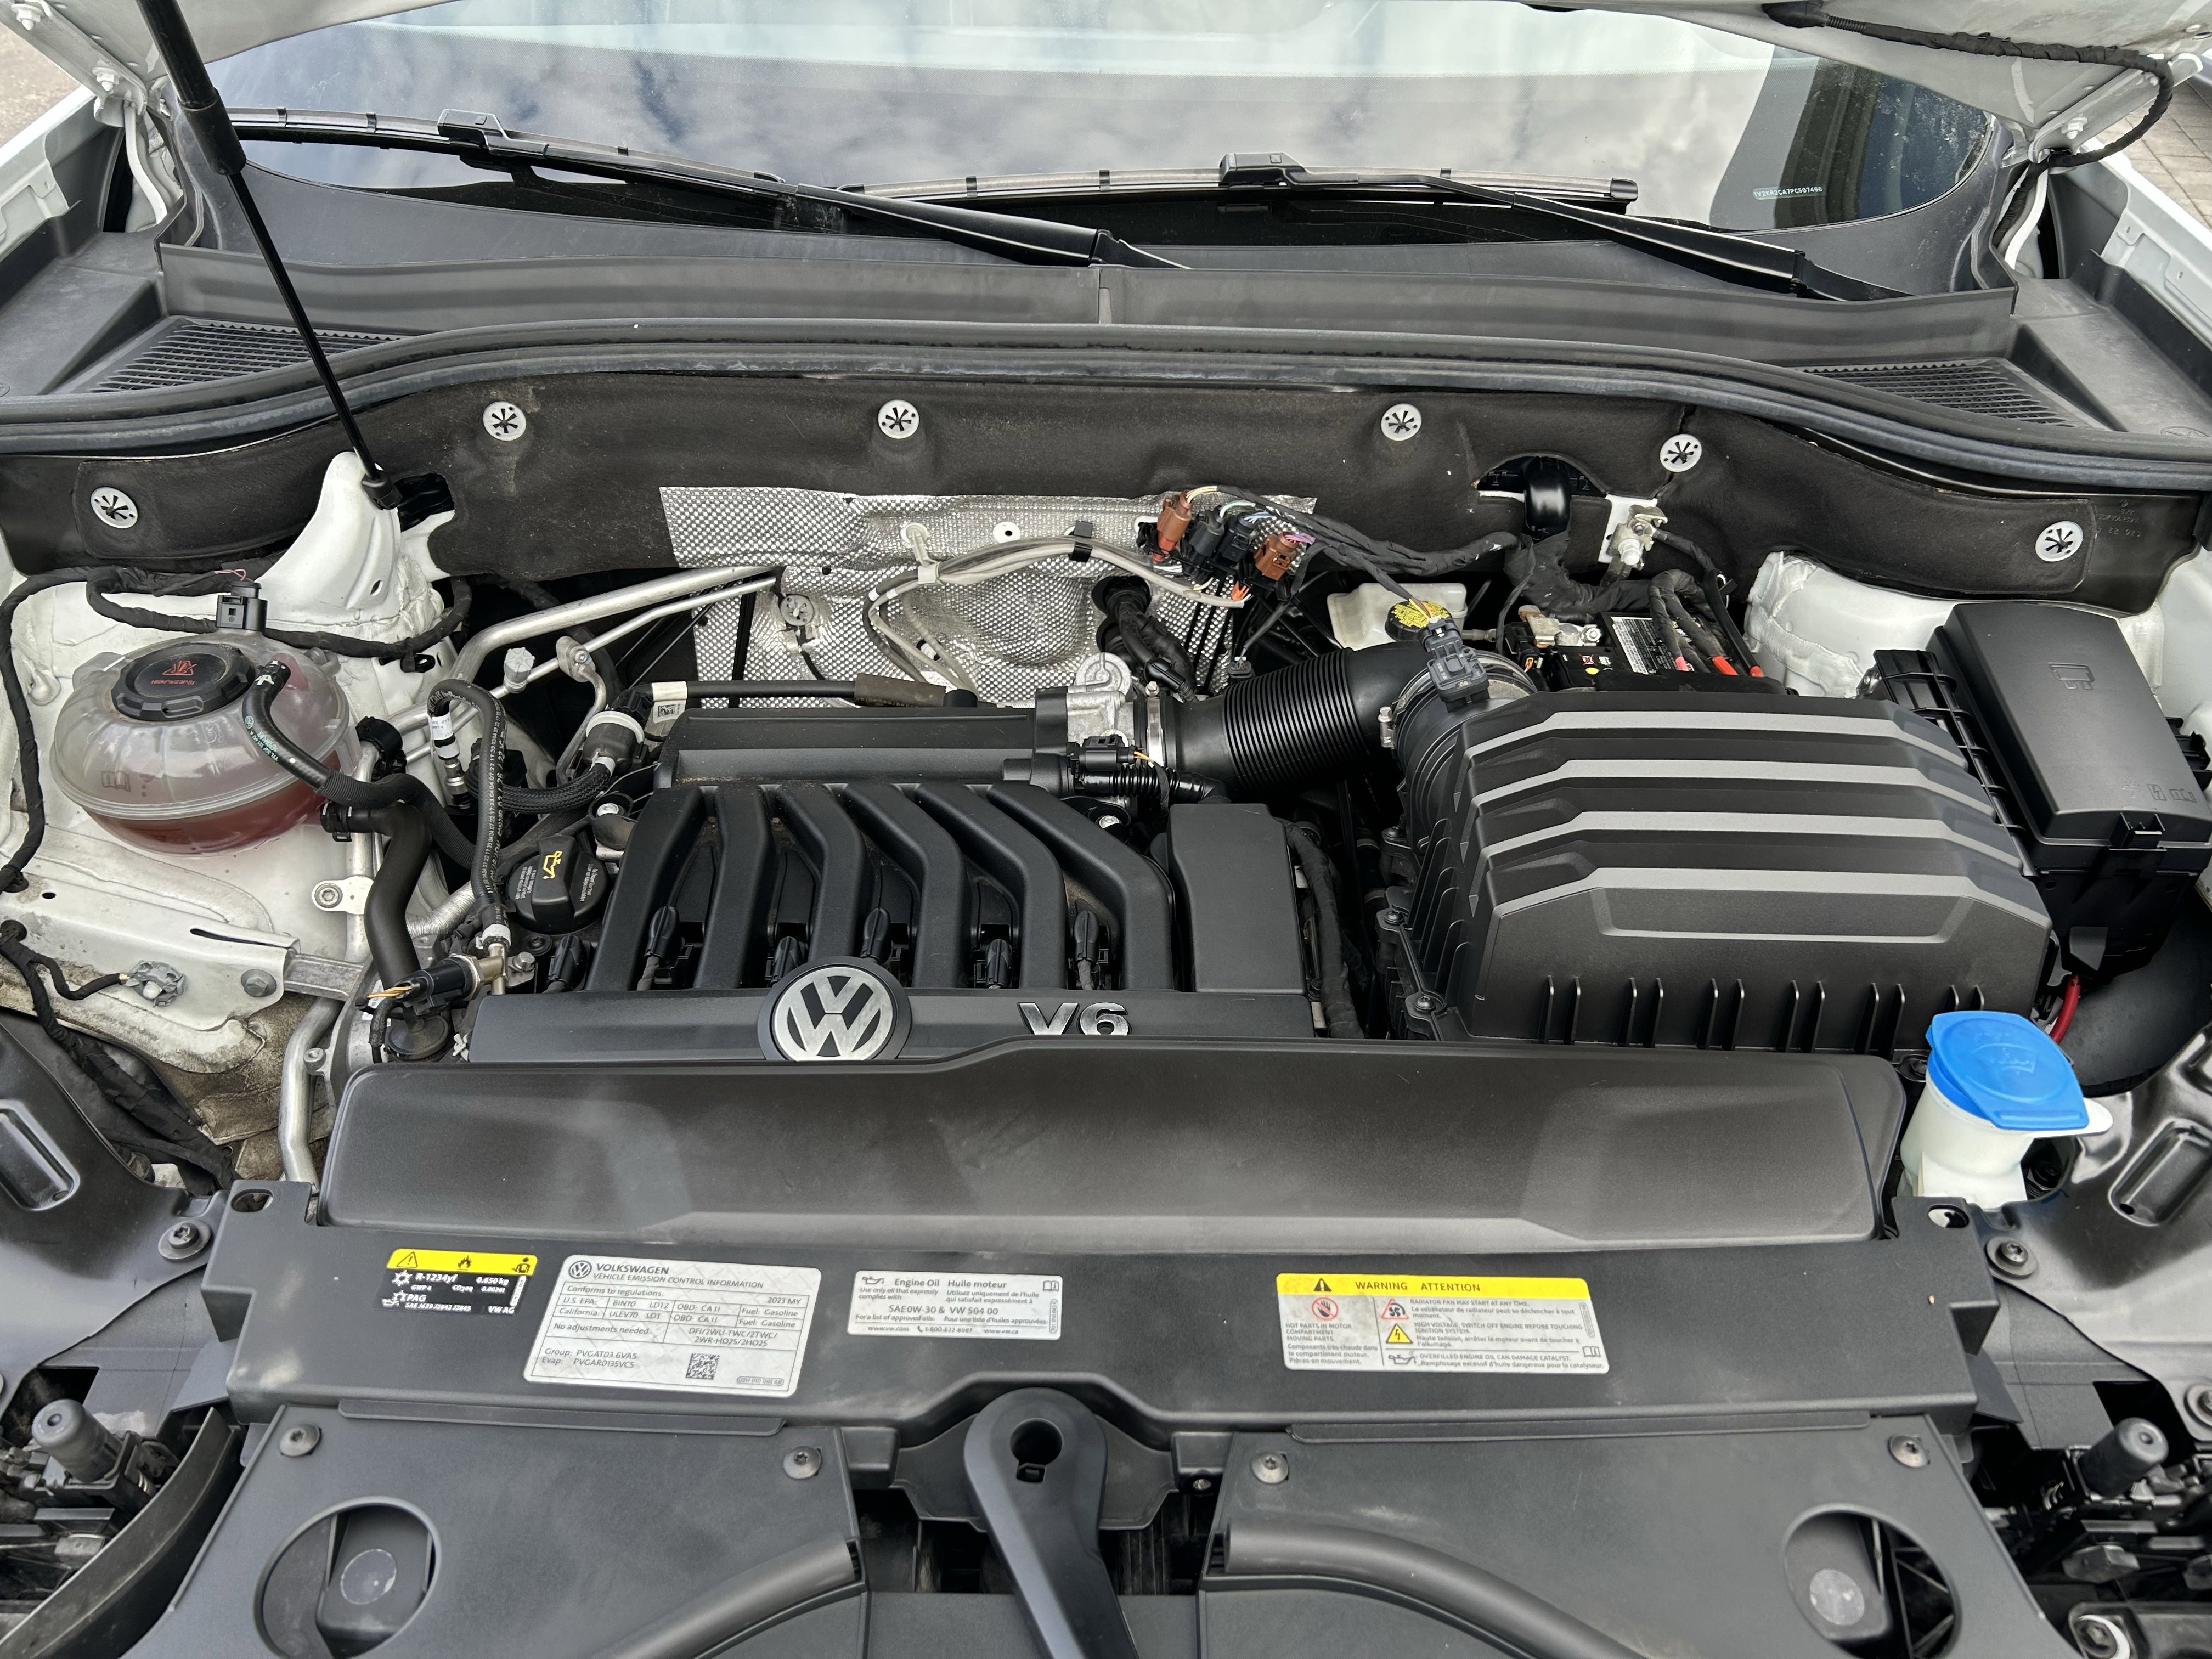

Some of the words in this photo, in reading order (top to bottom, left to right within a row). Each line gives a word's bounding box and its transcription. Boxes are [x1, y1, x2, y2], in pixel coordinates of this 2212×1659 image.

[1017, 1002, 1132, 1036] V6
[596, 1263, 670, 1274] VOLKSWAGEN
[415, 1273, 459, 1282] R-1234yf
[499, 1278, 509, 1286] kg
[668, 1276, 705, 1285] CONTROL
[707, 1279, 764, 1289] INFORMATION
[894, 1279, 925, 1287] Engine
[567, 1285, 605, 1294] Conforms
[617, 1289, 664, 1297] regulations:
[1355, 1282, 1408, 1290] WARNING
[1421, 1282, 1481, 1292] ATTENTION
[559, 1308, 600, 1316] California:
[761, 1319, 795, 1328] Gasoline
[764, 1308, 798, 1317] Gasoline
[567, 1324, 617, 1333] adjustments
[619, 1327, 650, 1335] needed.
[545, 1348, 573, 1356] Group:
[541, 1356, 563, 1365] Evap:
